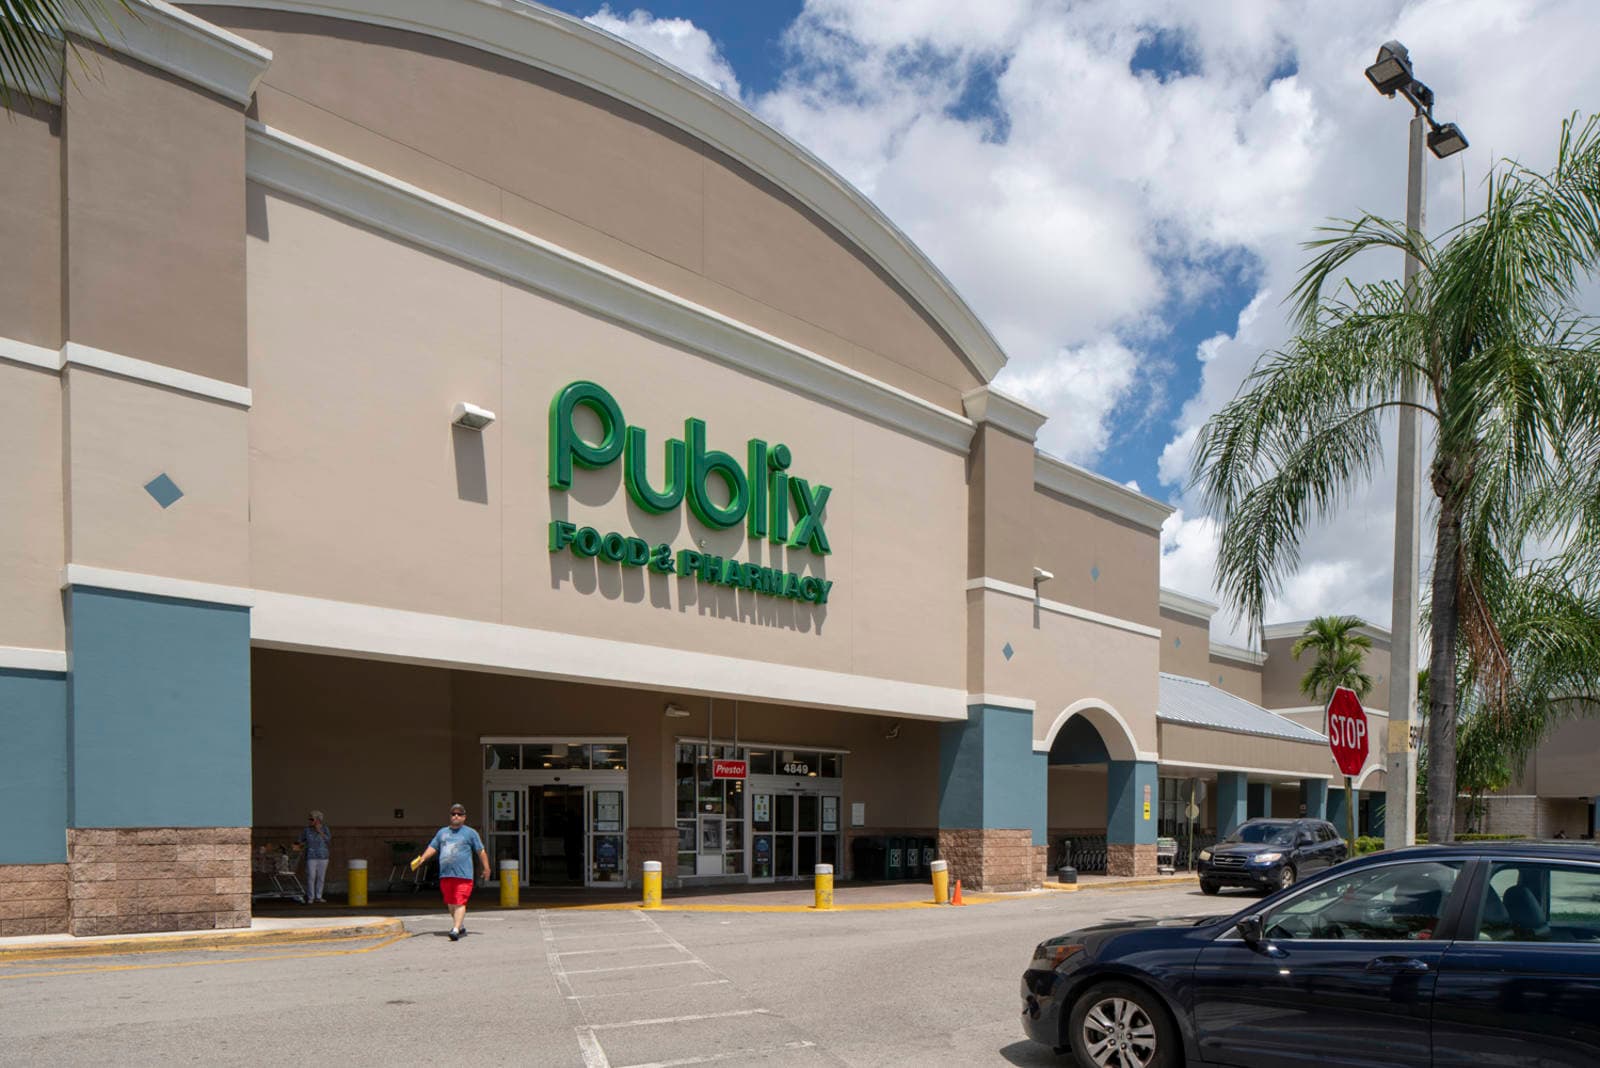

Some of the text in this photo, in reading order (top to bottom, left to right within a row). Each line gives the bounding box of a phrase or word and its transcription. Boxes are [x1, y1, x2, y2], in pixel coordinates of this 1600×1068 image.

[549, 380, 832, 555] Publix
[549, 520, 833, 605] FOOD & PHARMACY
[1331, 714, 1365, 750] STOP
[716, 764, 744, 774] Presto!
[783, 763, 809, 774] 4849
